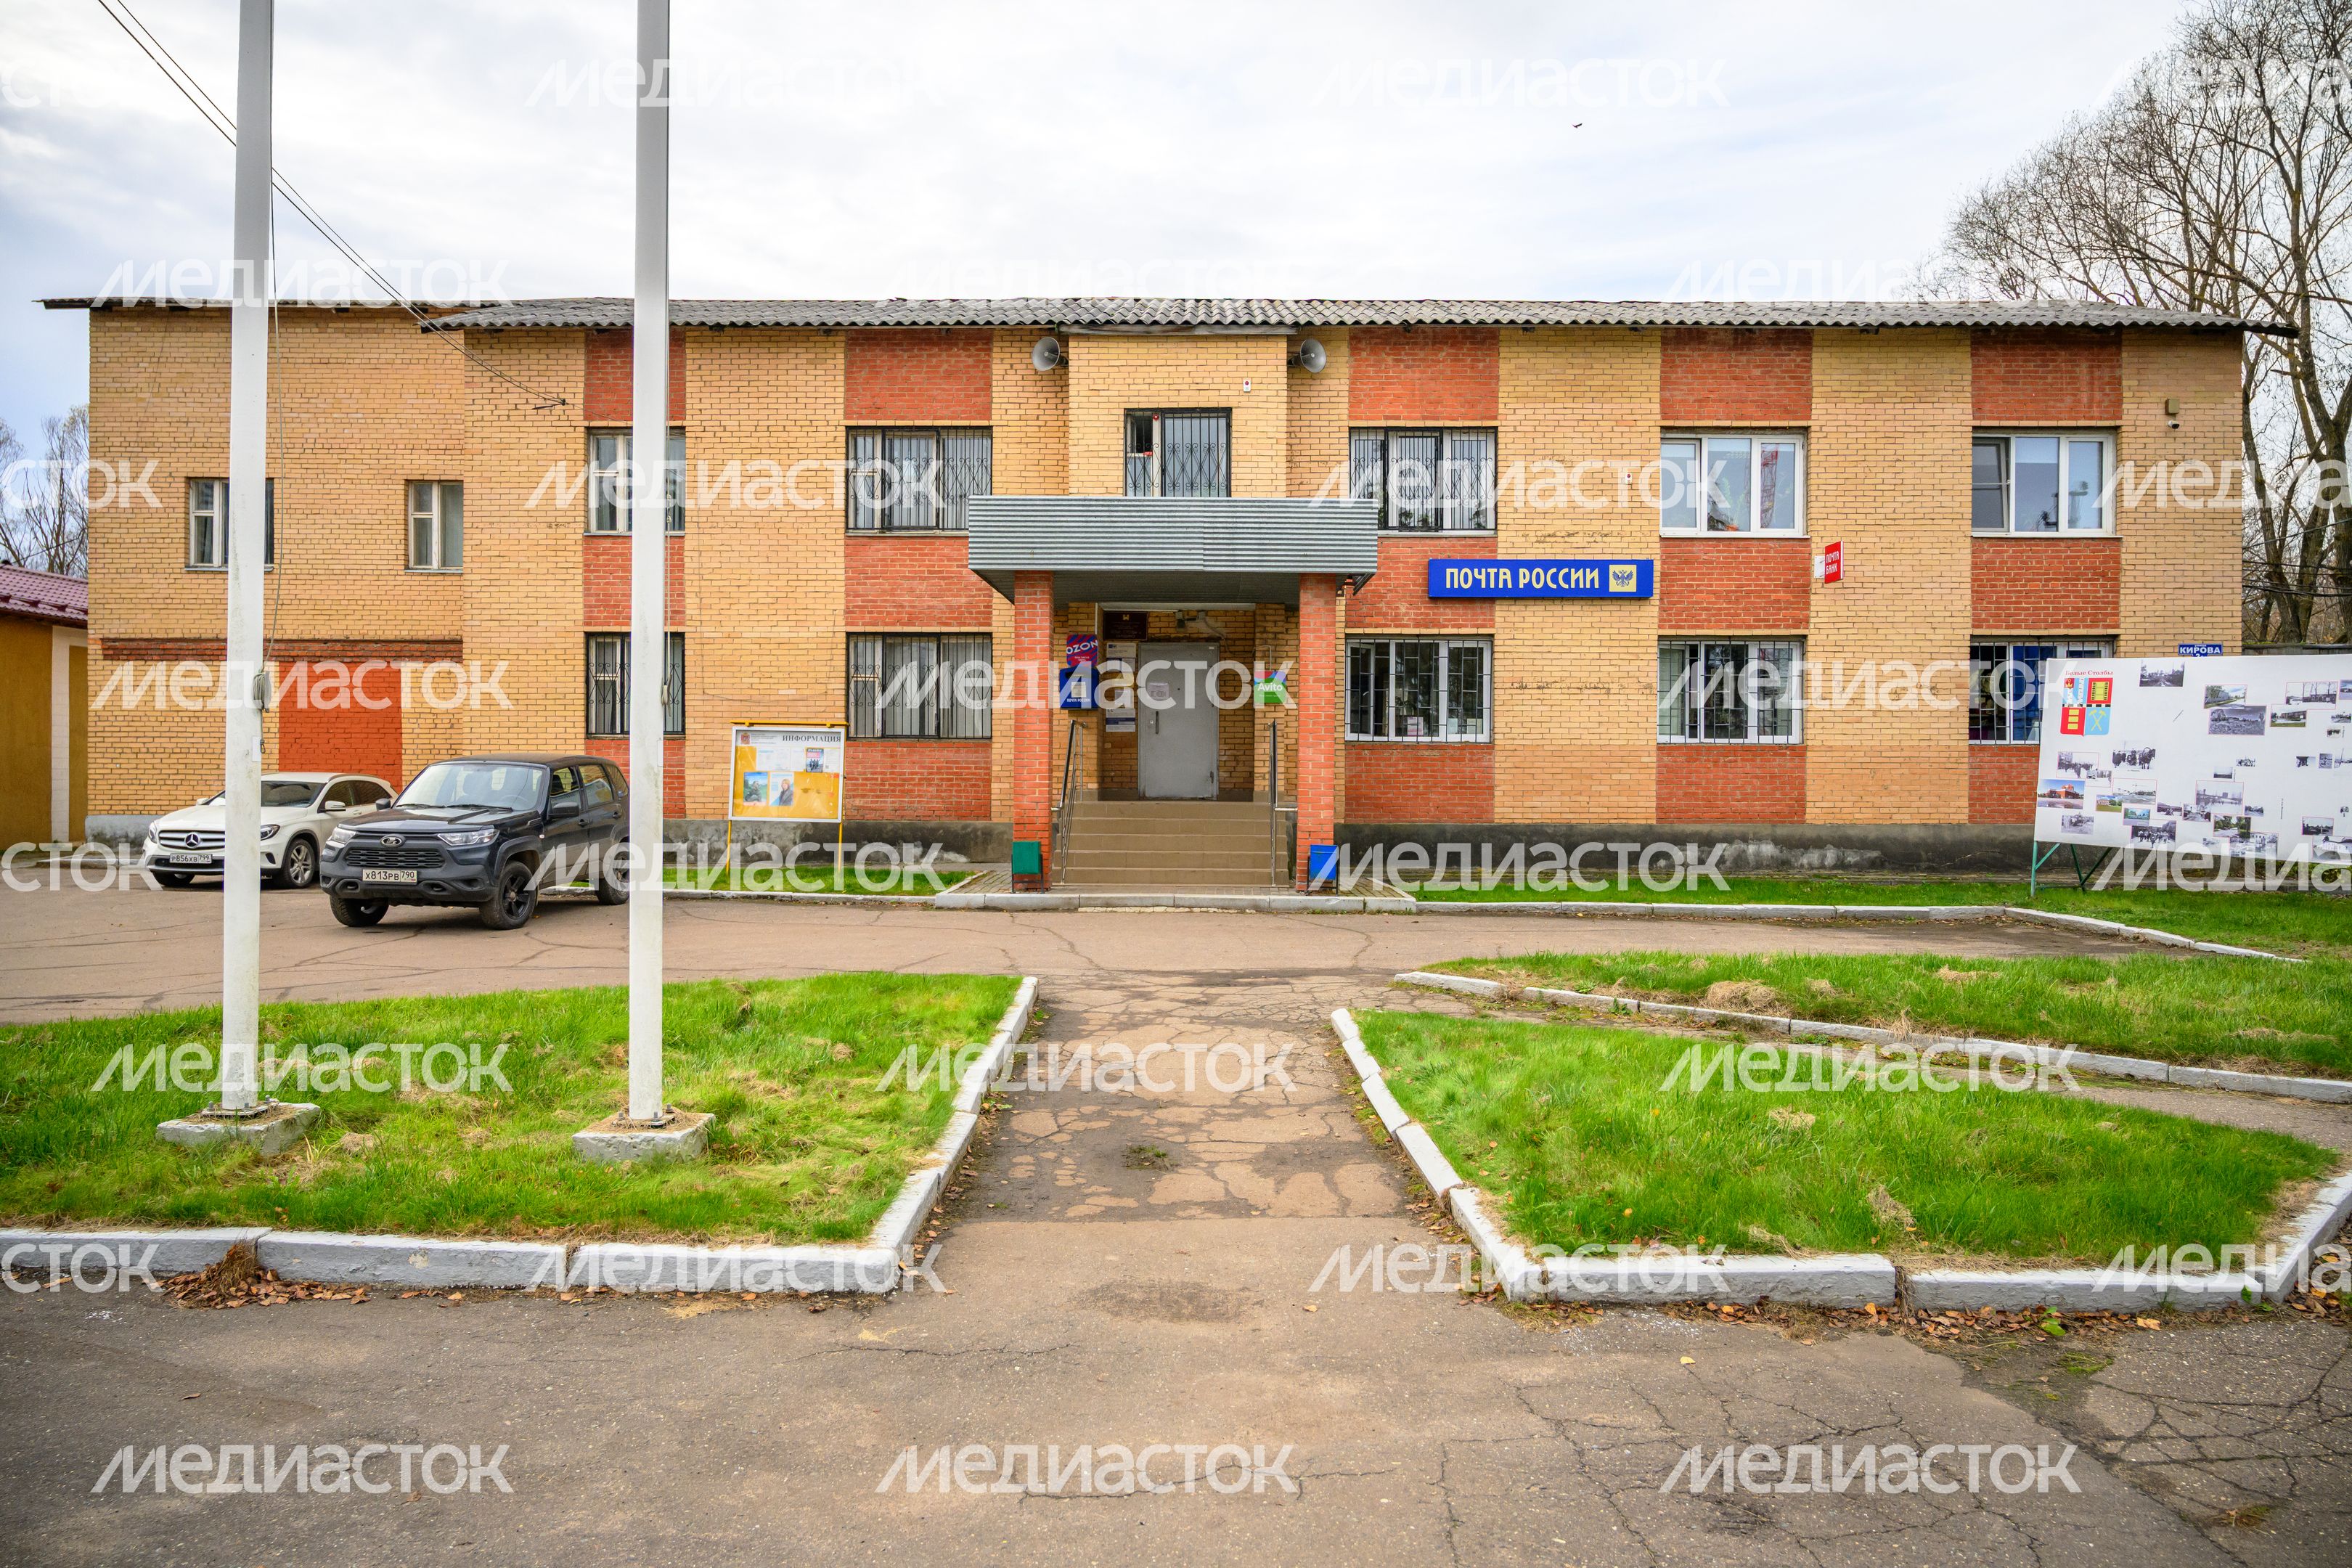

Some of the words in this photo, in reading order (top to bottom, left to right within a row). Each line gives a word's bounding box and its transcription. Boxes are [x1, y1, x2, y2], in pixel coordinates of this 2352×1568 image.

[1824, 550, 1839, 563] ПОЧТА
[1445, 568, 1512, 589] ПОЧТА
[1519, 568, 1599, 589] РОССИИ
[1066, 640, 1098, 655] OZON
[1257, 682, 1283, 692] Avito
[782, 734, 841, 743] ИНФОРМАЦИЯ
